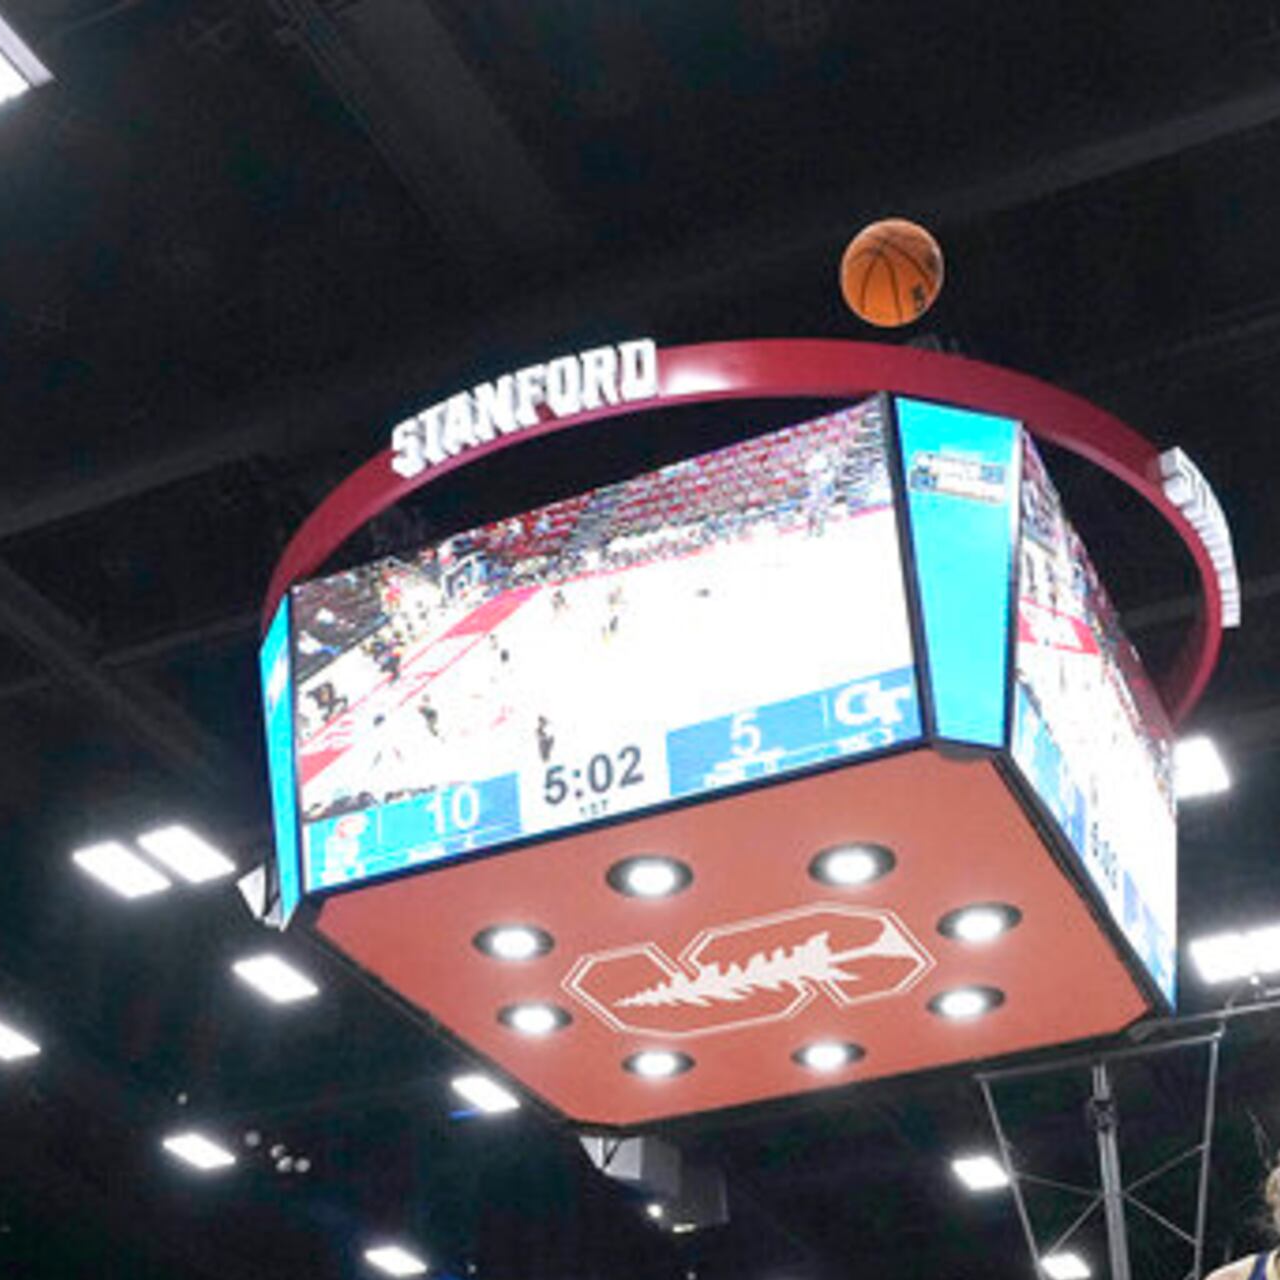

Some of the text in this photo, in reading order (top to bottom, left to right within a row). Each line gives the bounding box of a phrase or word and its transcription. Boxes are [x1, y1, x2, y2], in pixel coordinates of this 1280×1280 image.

[391, 337, 659, 479] STANFORD
[730, 711, 761, 757] 5
[543, 745, 645, 805] 5:02
[425, 783, 481, 835] 10
